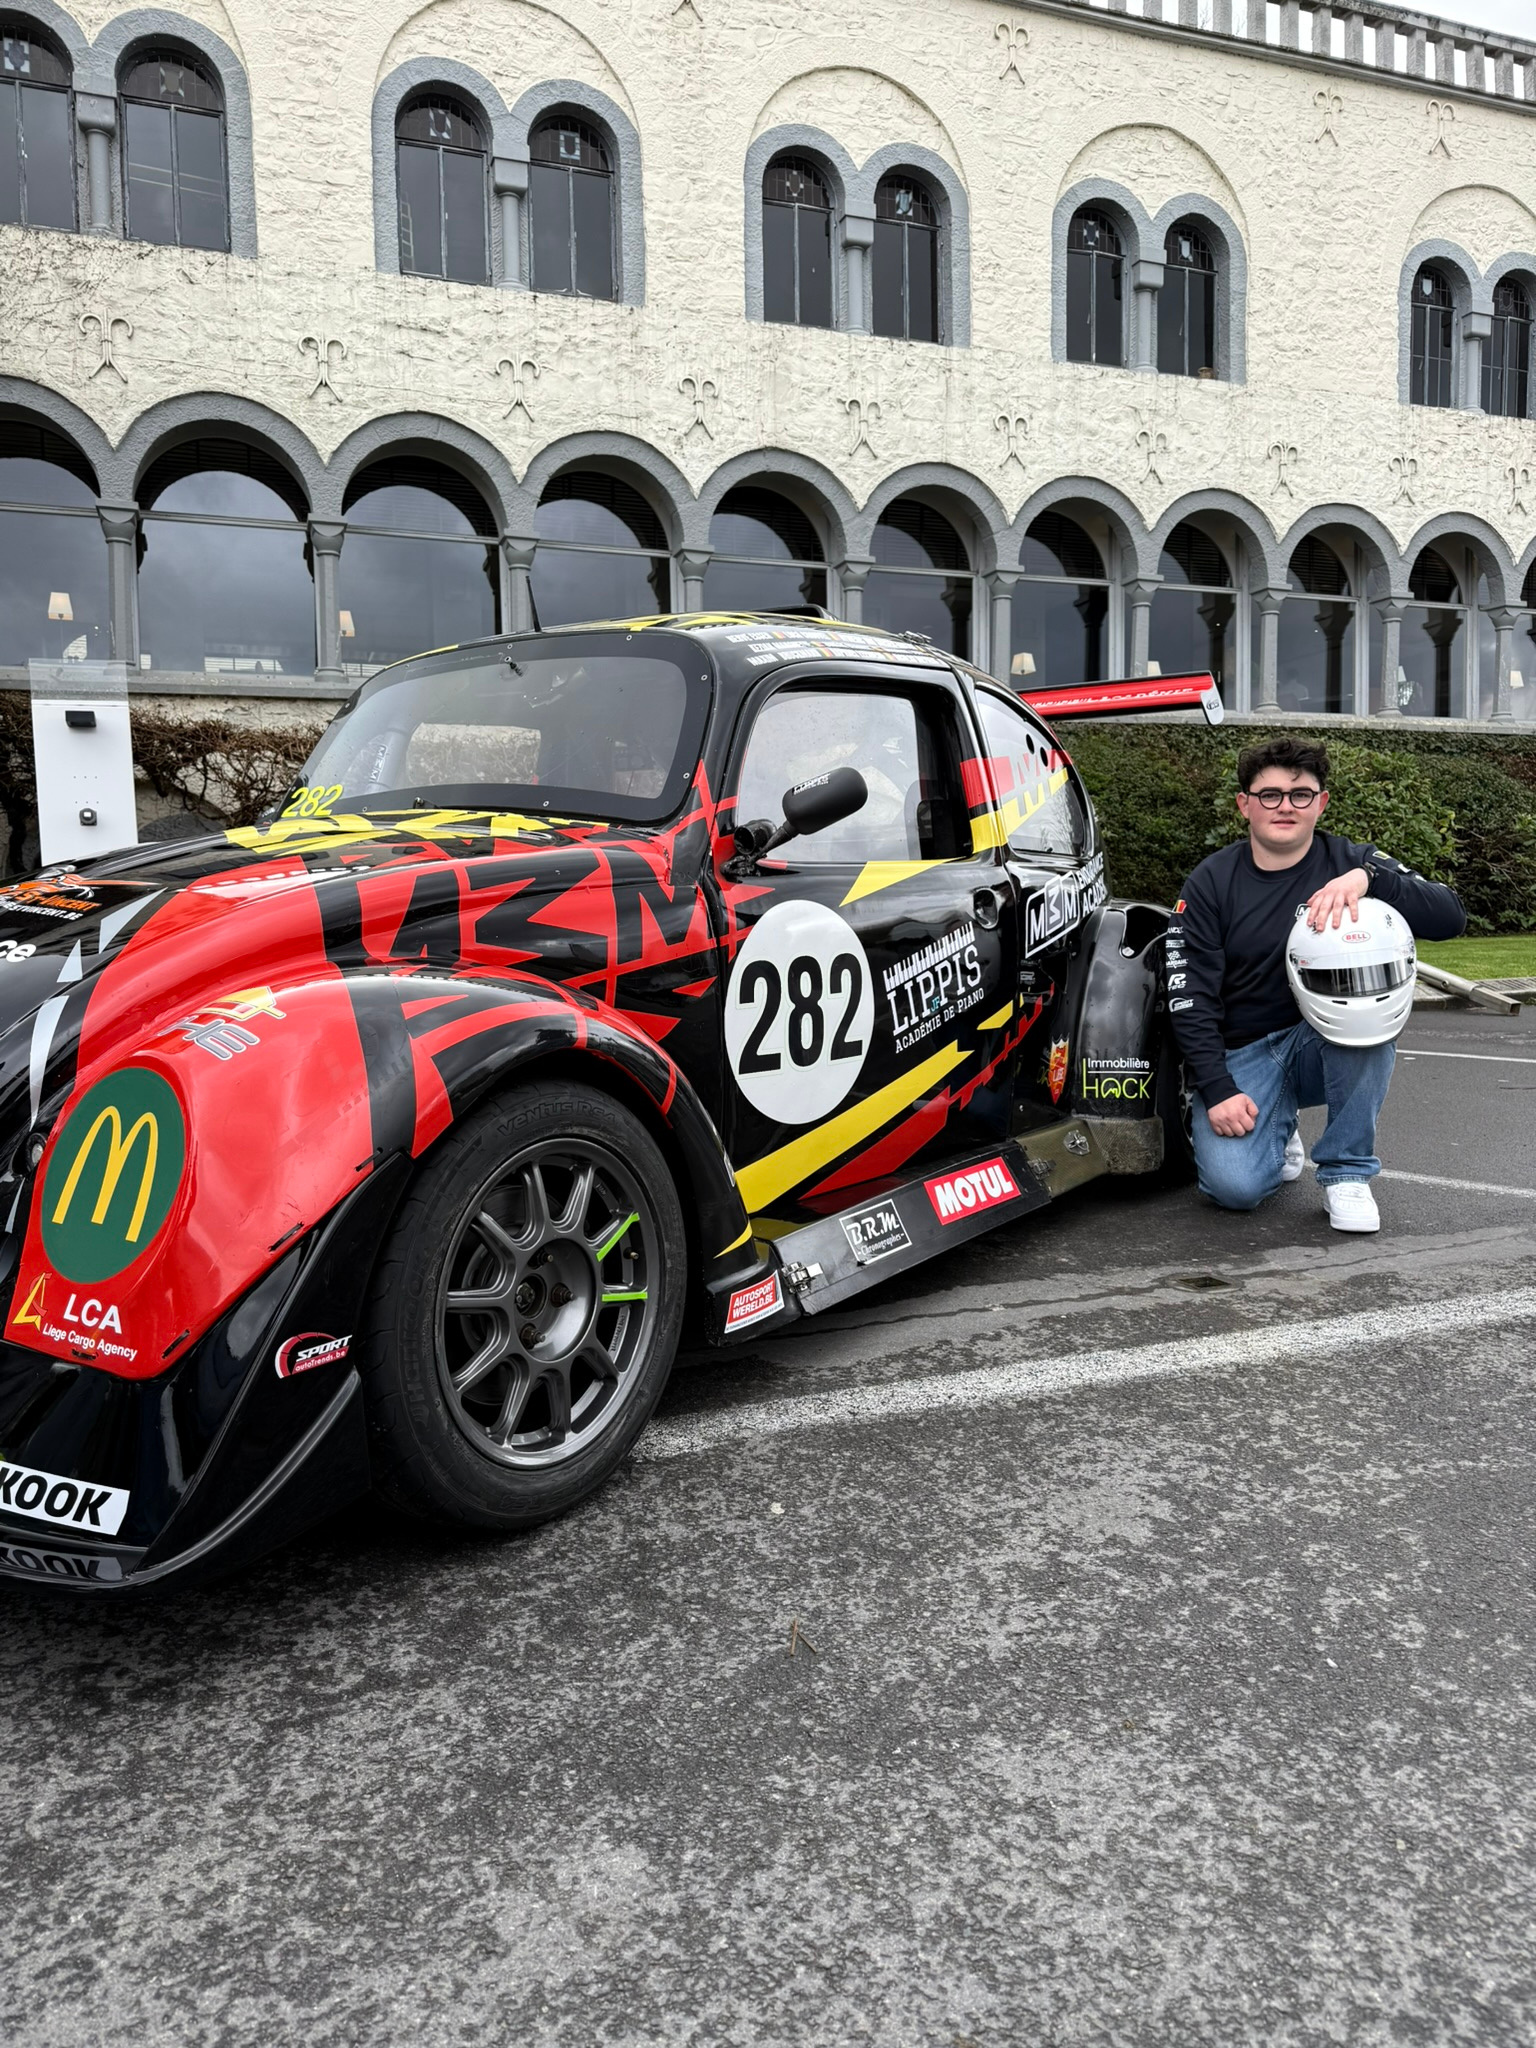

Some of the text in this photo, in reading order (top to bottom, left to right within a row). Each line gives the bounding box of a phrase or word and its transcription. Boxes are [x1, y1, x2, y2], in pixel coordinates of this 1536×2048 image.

[281, 784, 343, 818] 282
[887, 944, 981, 1036] LIPPIS
[738, 953, 863, 1075] 282
[895, 988, 985, 1054] ACADÉMIE DE PIANO
[1087, 1058, 1149, 1069] Immobilière
[934, 1165, 1014, 1218] MOTUL
[63, 1293, 122, 1334] LCA
[732, 1292, 774, 1319] WERELD.BE
[733, 1280, 774, 1309] AUTOSPORT
[42, 1322, 138, 1362] Liege Cargo Agency
[295, 1334, 353, 1363] SPORT
[0, 1466, 112, 1527] KOOK
